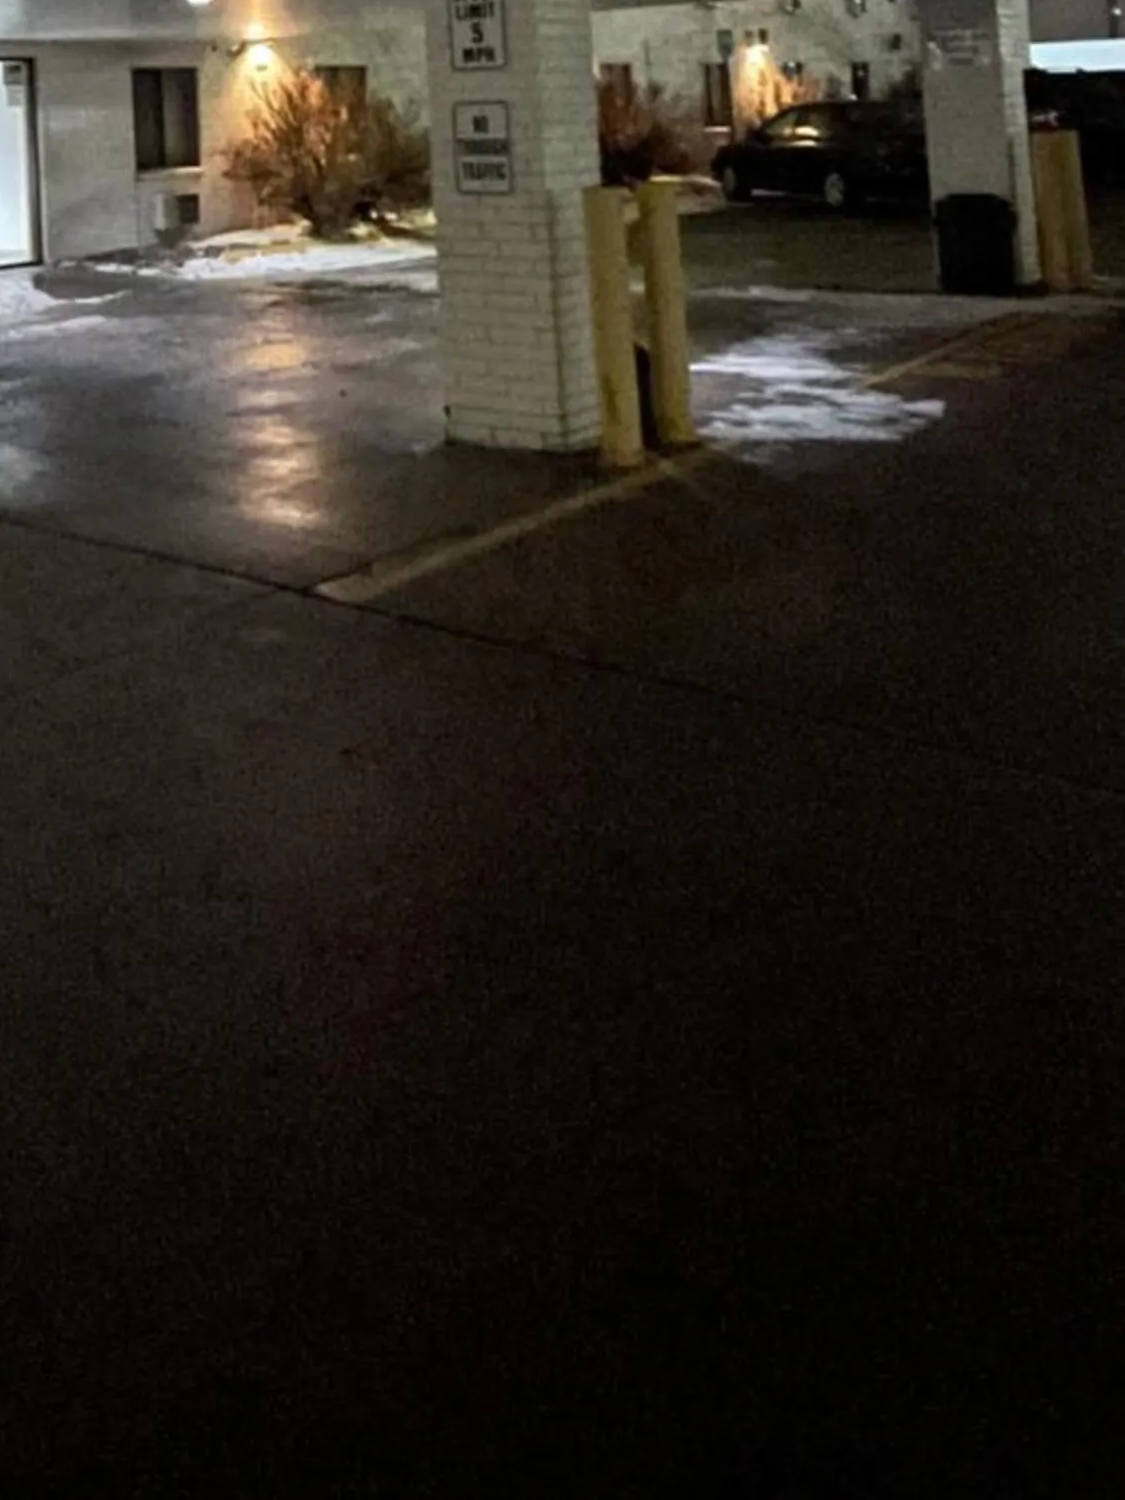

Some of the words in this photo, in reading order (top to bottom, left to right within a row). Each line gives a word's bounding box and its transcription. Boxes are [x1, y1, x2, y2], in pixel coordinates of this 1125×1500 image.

[455, 2, 495, 21] LIMIT
[471, 22, 484, 44] 5
[462, 47, 496, 64] MPH
